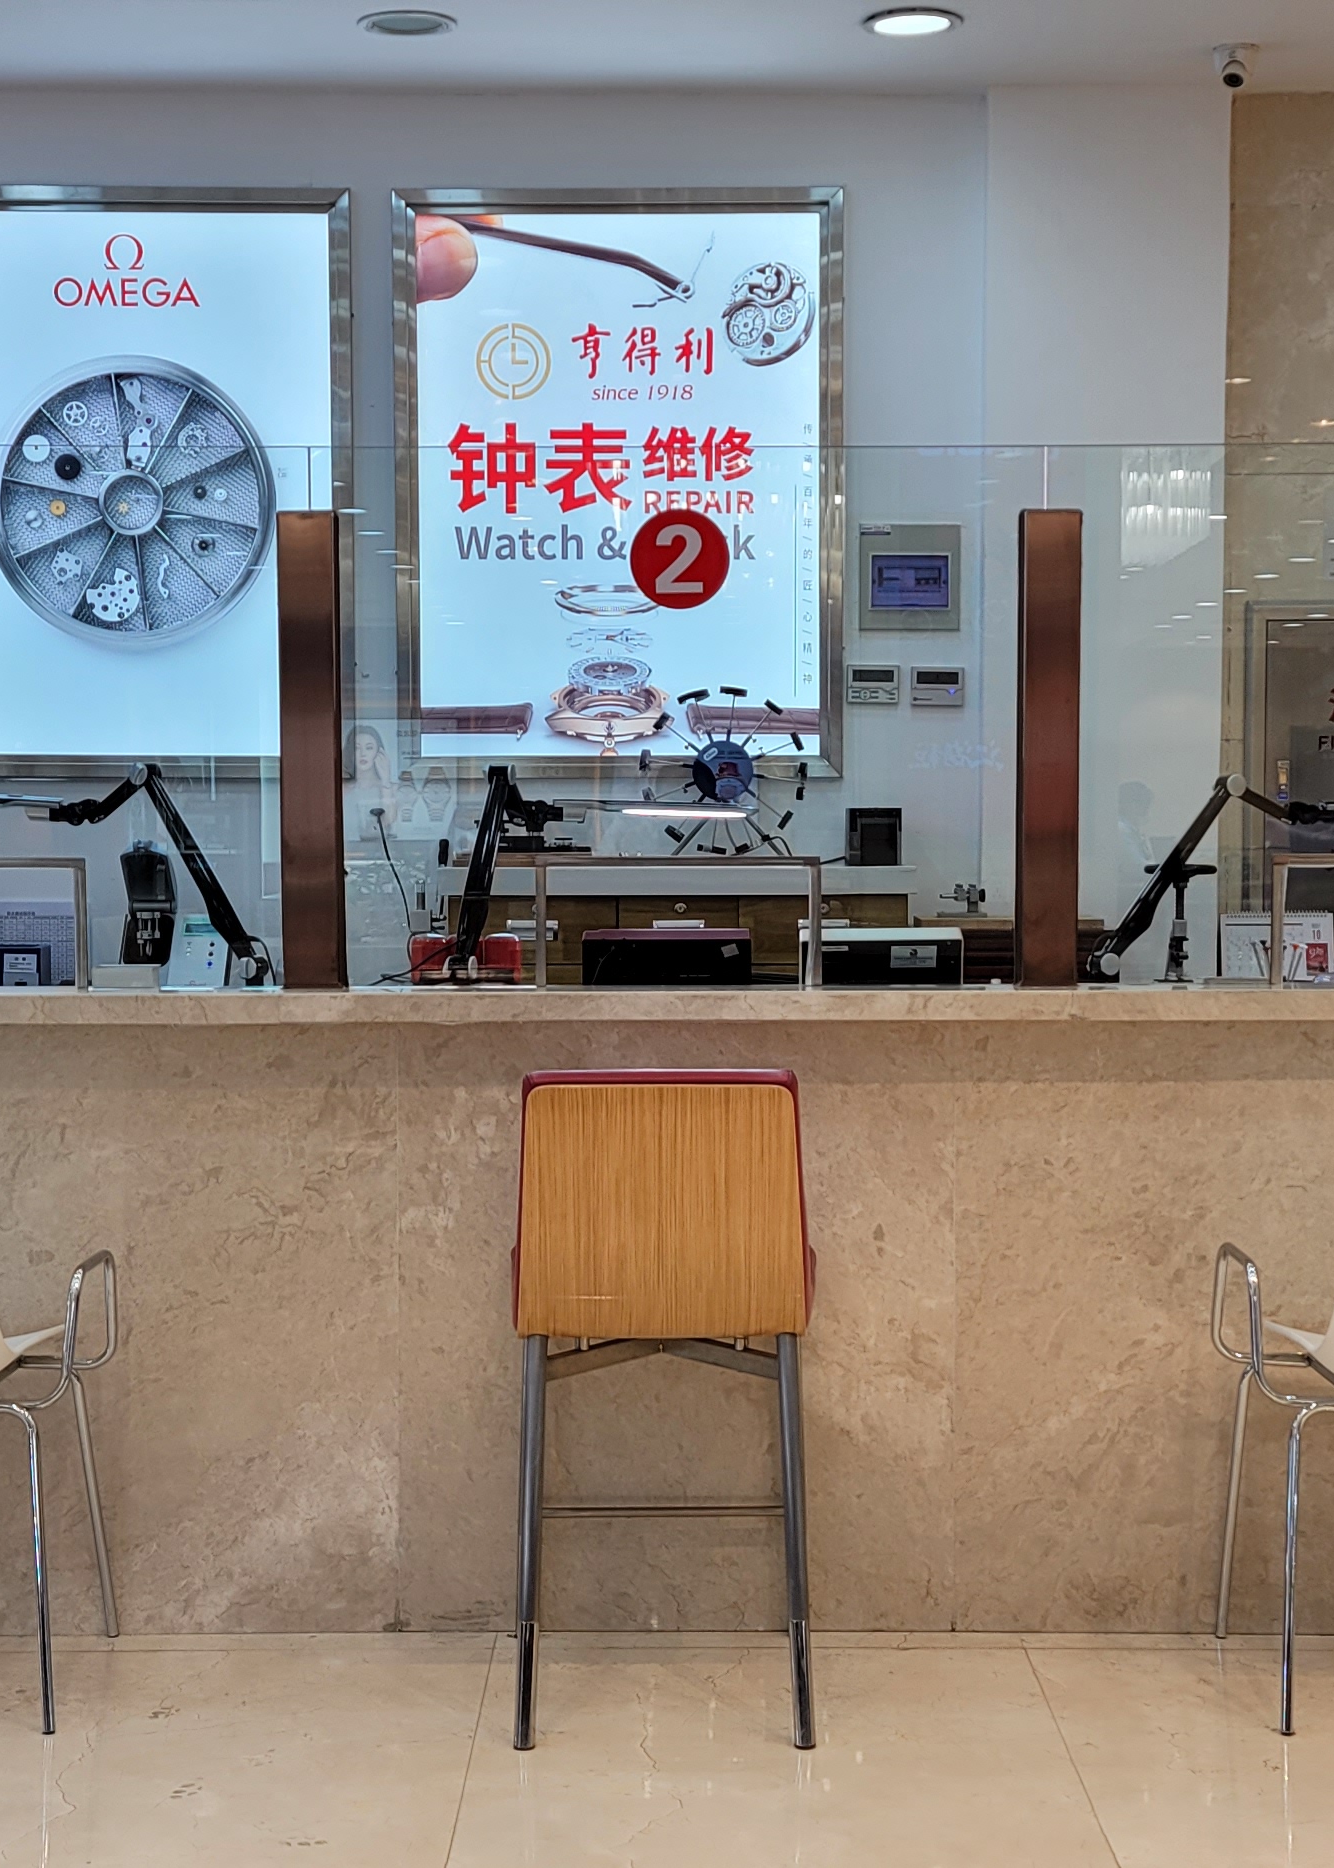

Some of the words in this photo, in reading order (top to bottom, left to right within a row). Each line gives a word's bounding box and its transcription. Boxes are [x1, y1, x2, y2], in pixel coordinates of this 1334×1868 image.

[53, 277, 201, 308] OMEGA
[571, 322, 715, 379] 亨得利
[590, 386, 638, 402] since
[646, 385, 694, 402] 1918
[447, 422, 633, 514] 钟表
[642, 426, 755, 483] 维修
[644, 491, 754, 515] REPAIR
[455, 525, 584, 561] Watch
[599, 526, 628, 561] &
[654, 524, 704, 594] 2
